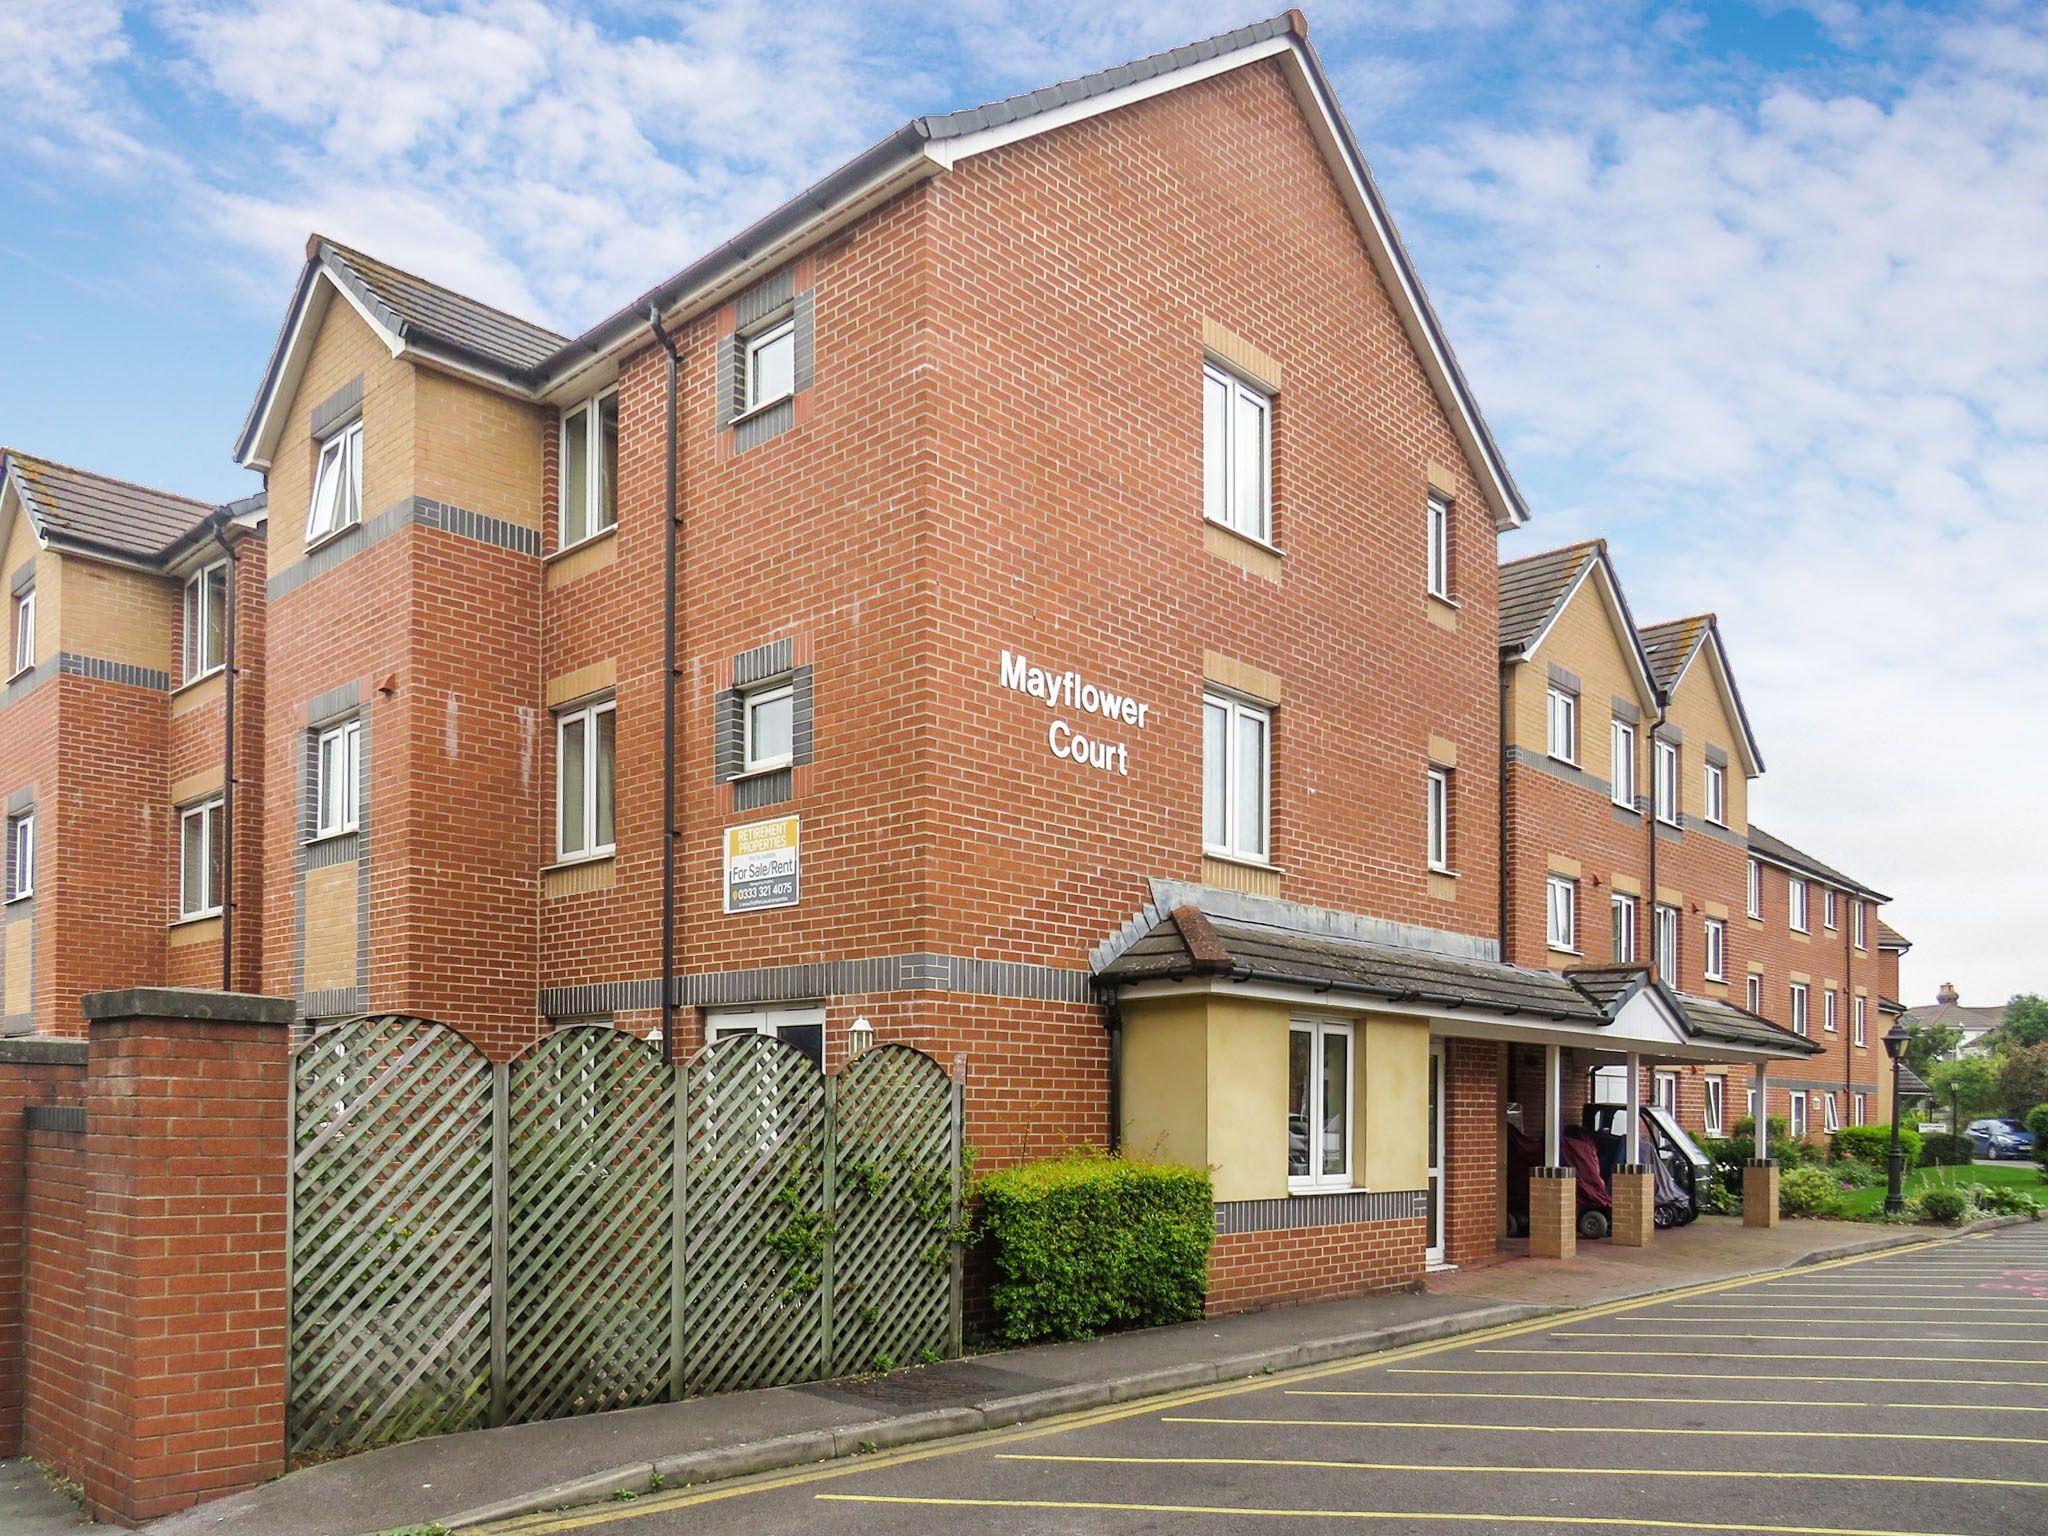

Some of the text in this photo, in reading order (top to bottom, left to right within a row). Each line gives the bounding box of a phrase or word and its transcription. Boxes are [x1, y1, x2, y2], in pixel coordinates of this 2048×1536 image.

[1000, 650, 1148, 728] Mayflower
[1049, 720, 1128, 775] Court
[738, 822, 787, 843] RETIREMENT
[738, 835, 787, 854] PROPERTIES
[732, 858, 793, 880] For Sale/Rent
[738, 886, 757, 900] 0333
[758, 884, 771, 897] 321
[772, 881, 792, 895] 4075
